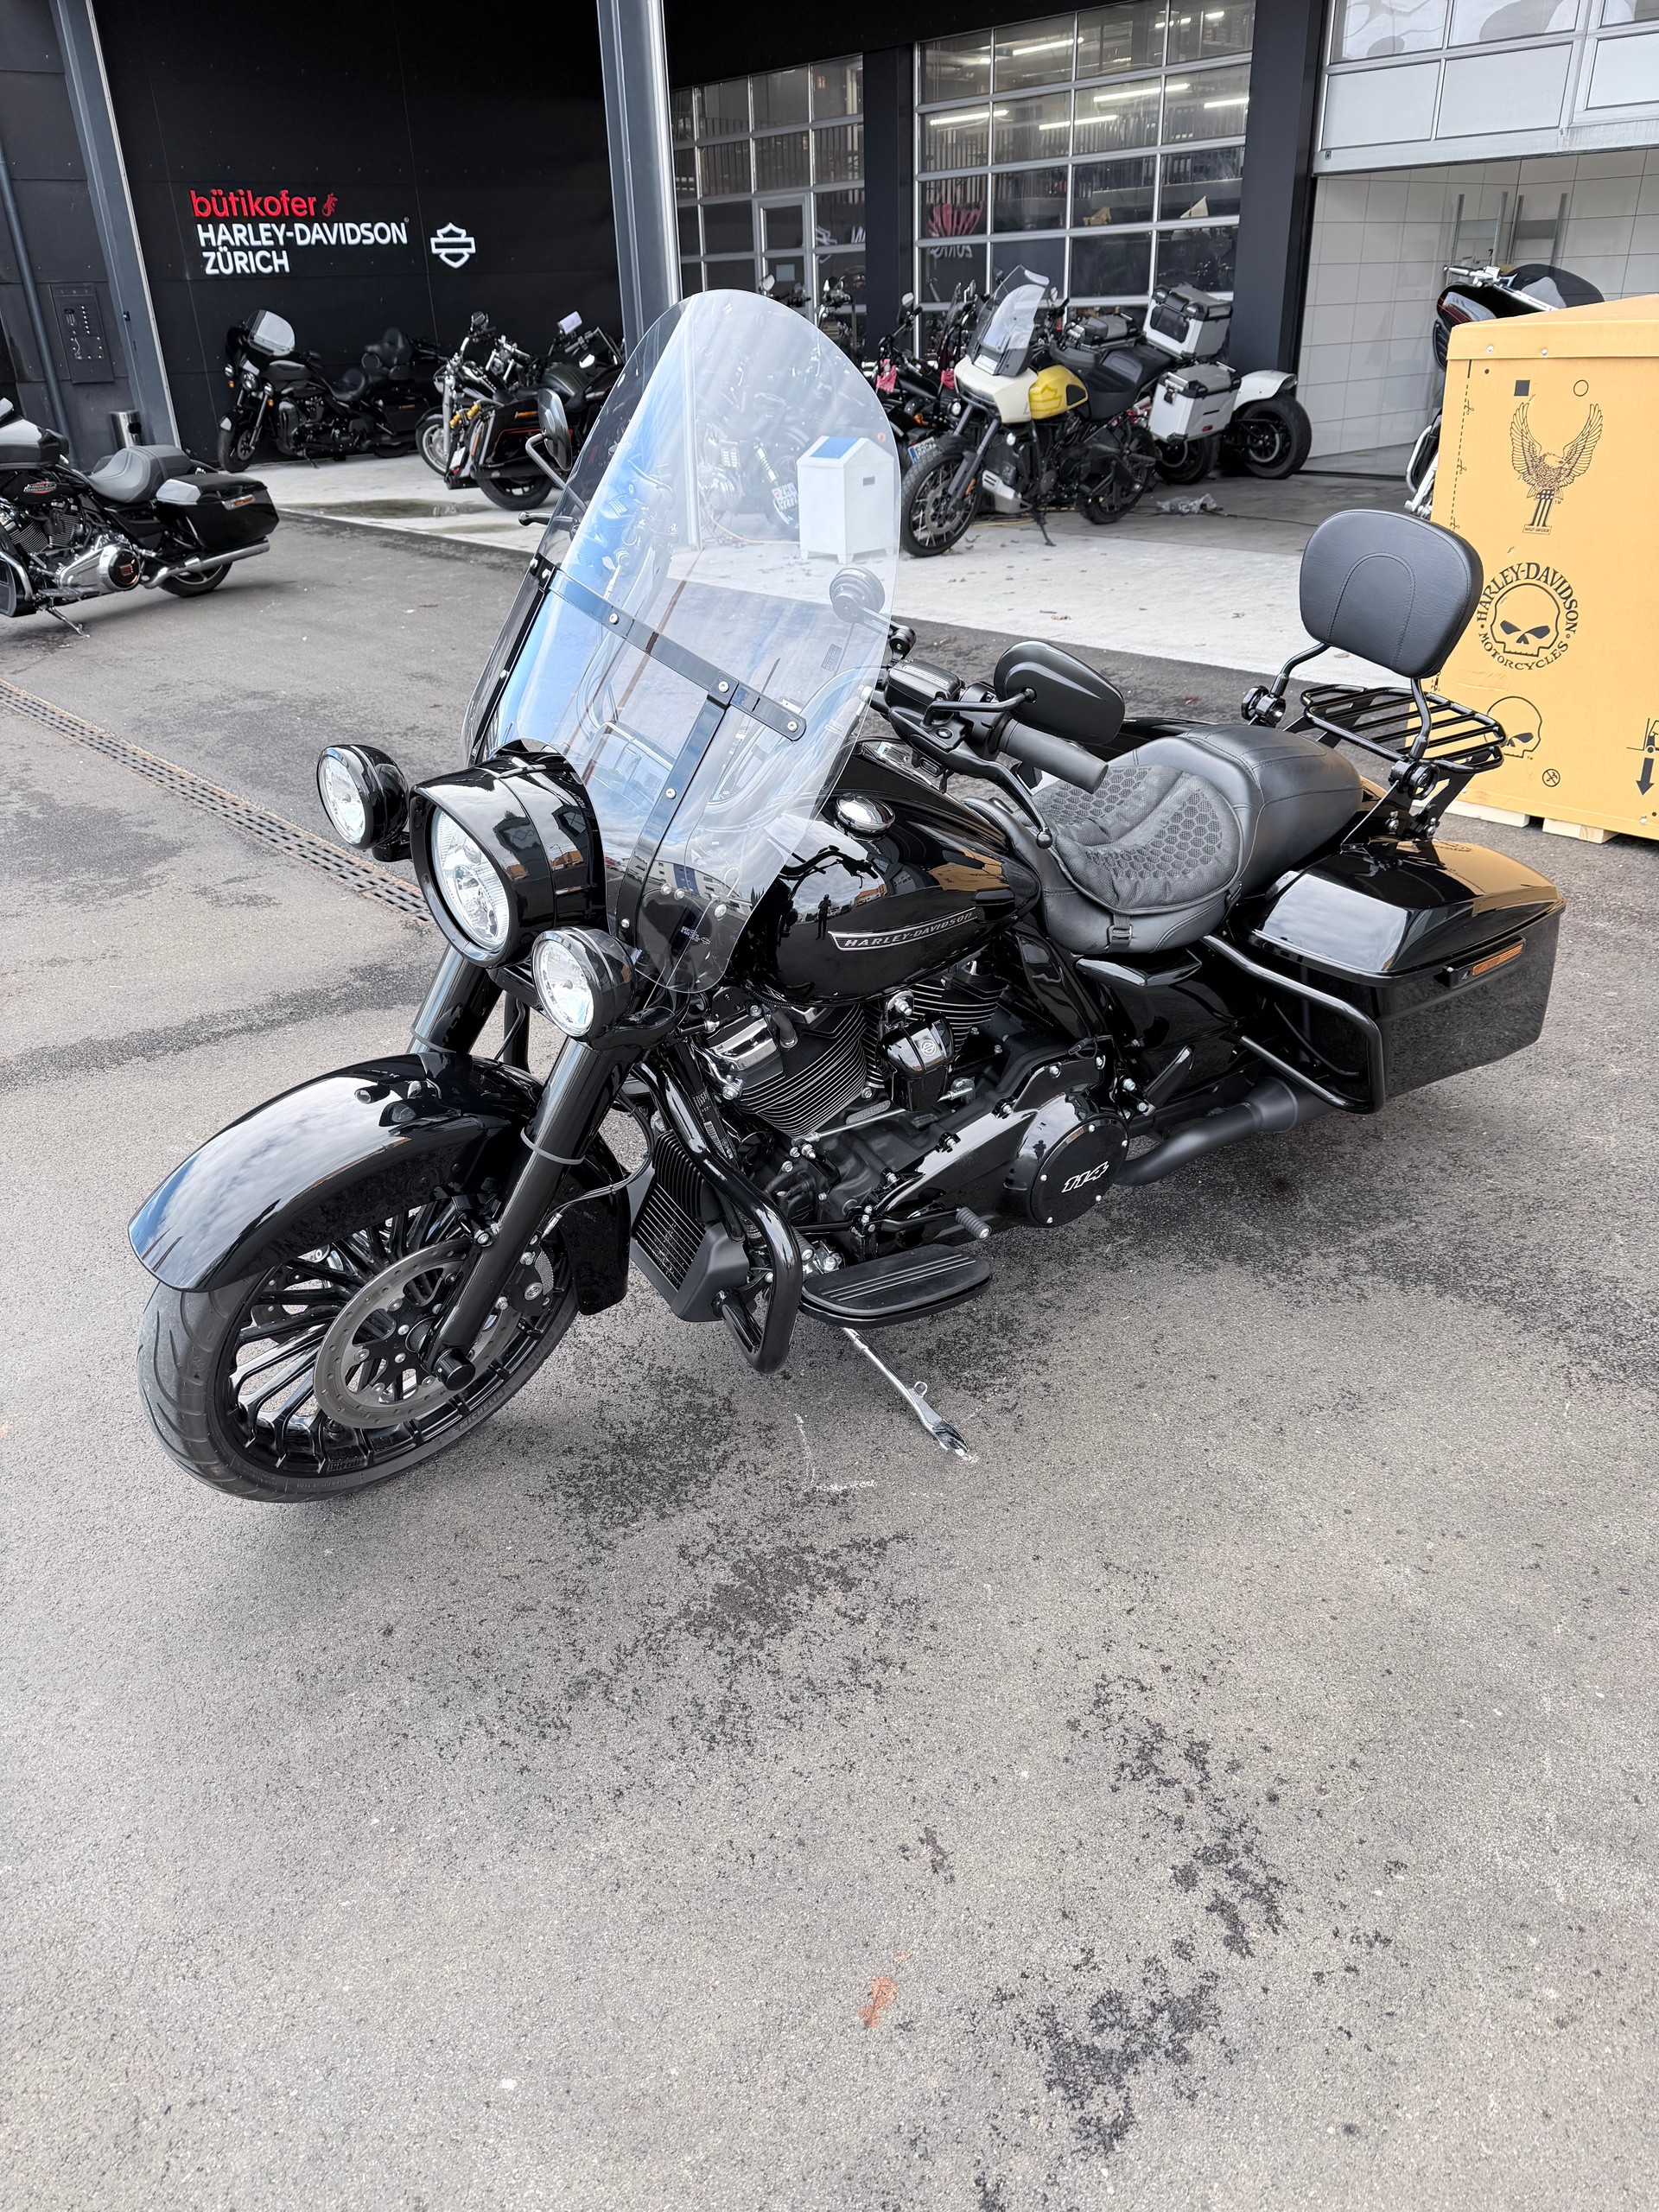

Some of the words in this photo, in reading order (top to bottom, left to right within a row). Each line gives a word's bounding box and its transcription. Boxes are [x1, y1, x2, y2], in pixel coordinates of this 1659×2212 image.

[189, 189, 317, 218] bütikofer
[197, 222, 408, 248] HARLEY-DAVIDSON
[201, 245, 290, 276] ZÜRICH
[1477, 562, 1580, 635] HARLEY-DAVIDSON
[1478, 639, 1569, 671] MOTORCYCLES
[843, 912, 974, 948] HARLEY-DAVIDSON
[1061, 1160, 1109, 1193] 114
[458, 1389, 505, 1431] MICHELIN
